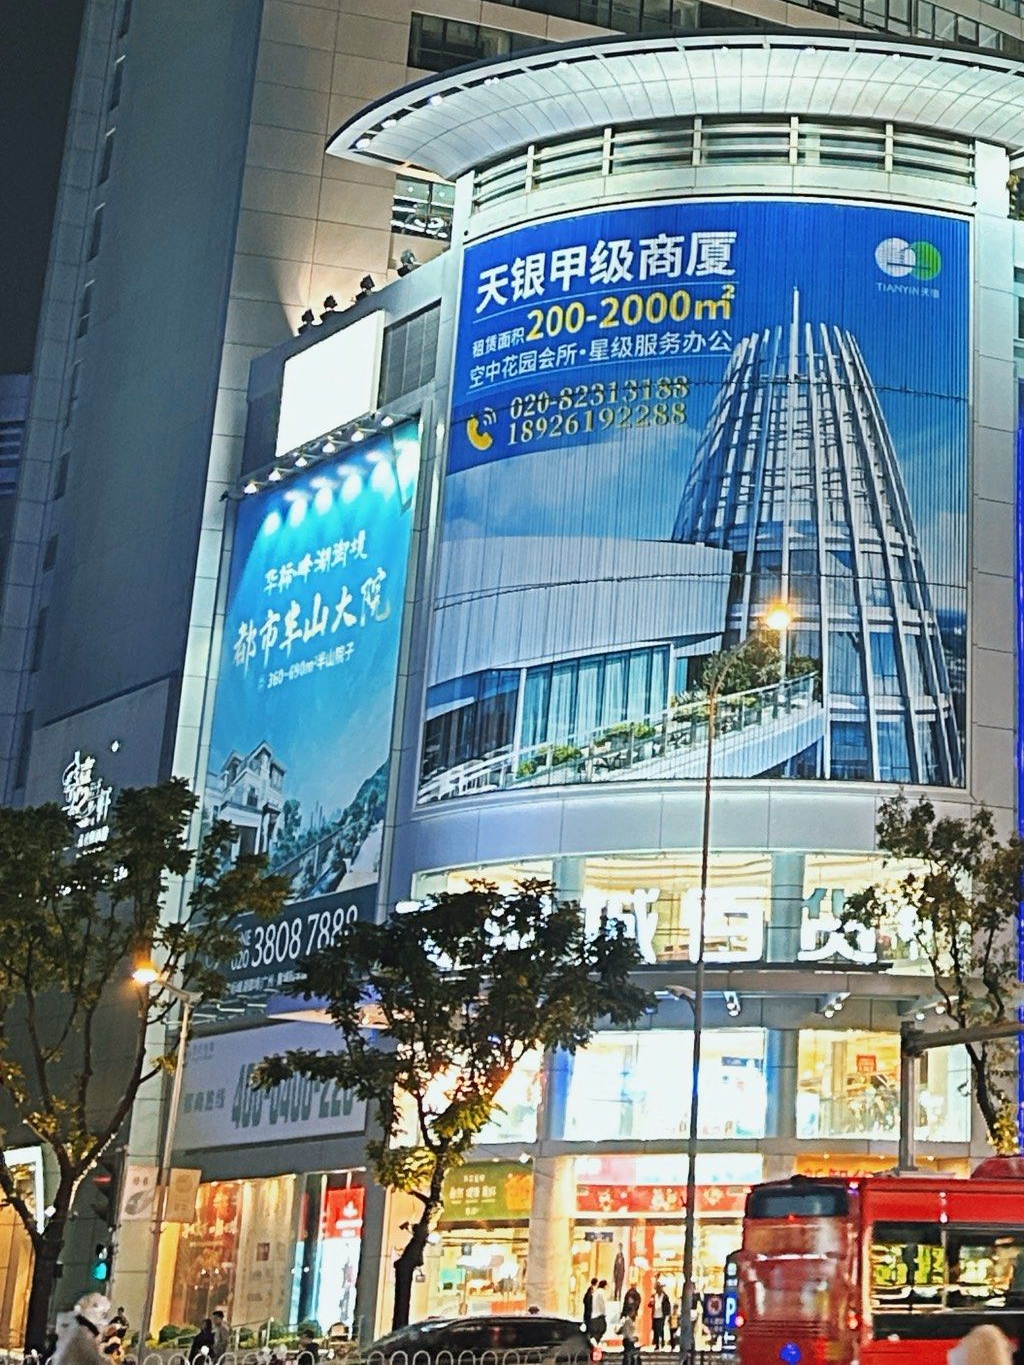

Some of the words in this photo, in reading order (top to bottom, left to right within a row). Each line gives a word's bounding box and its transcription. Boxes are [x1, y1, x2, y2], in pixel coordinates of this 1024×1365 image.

[475, 232, 737, 314] 天银甲级商厦
[510, 376, 689, 419] 020-82313188
[507, 403, 686, 446] 18926192288
[251, 917, 302, 968] 3808
